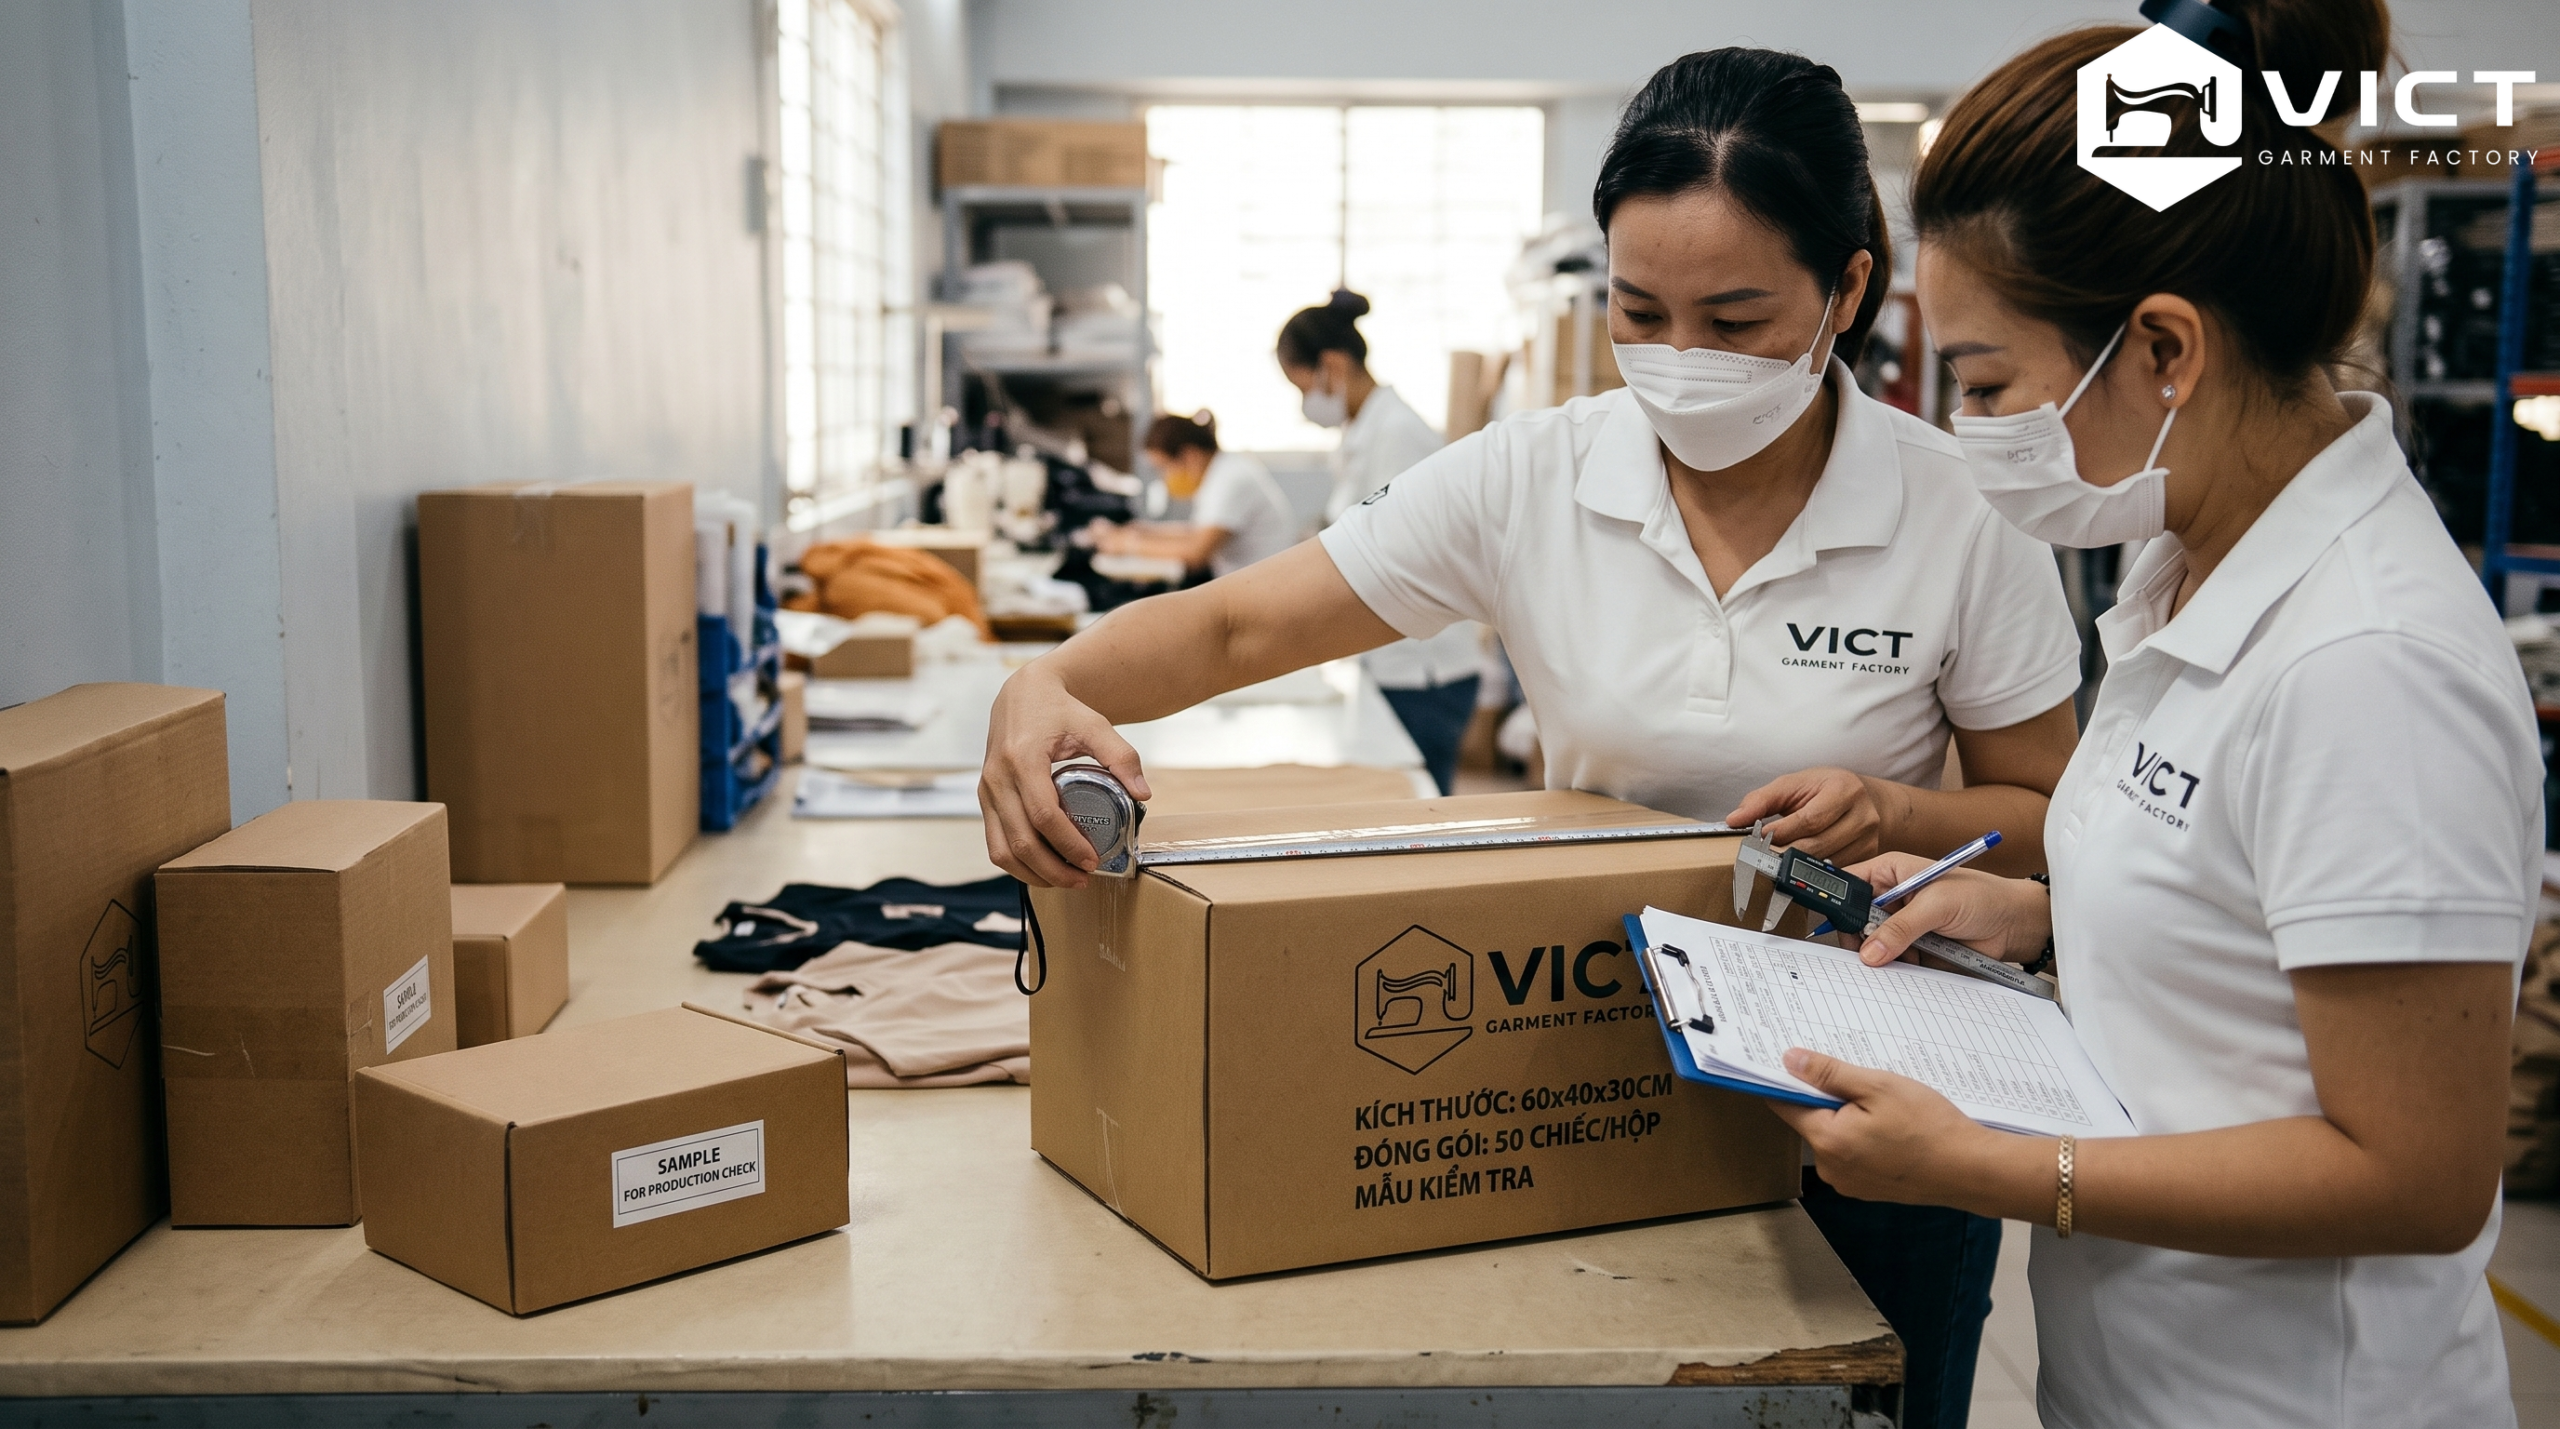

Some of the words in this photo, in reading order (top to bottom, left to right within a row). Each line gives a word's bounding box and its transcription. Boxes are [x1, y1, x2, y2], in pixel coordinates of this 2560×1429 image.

[1786, 622, 1914, 659] VICT
[1781, 657, 1845, 670] GARMENT
[1851, 662, 1910, 675] FACTORY
[2132, 741, 2201, 809] VICT
[2138, 799, 2191, 832] FACTORY
[1486, 1011, 1577, 1034] GARMENT
[1583, 1004, 1655, 1024] FACTOR
[1355, 1099, 1415, 1131] KÍCH
[1420, 1087, 1515, 1123] THƯỚC:
[1521, 1073, 1673, 1112] 60x40x30CM
[1354, 1137, 1430, 1170] ĐÓNG
[1436, 1130, 1488, 1160] GÓI:
[1494, 1128, 1524, 1153] 50
[1529, 1108, 1661, 1149] CHIẾC/HỘP
[657, 1147, 721, 1175] SAMPLE
[624, 1186, 646, 1202] FOR
[648, 1169, 720, 1196] PRODUCTION
[721, 1161, 757, 1179] CHECK
[1355, 1171, 1413, 1209] MẪU
[1419, 1164, 1480, 1201] KIỂM
[1486, 1165, 1534, 1192] TRA
